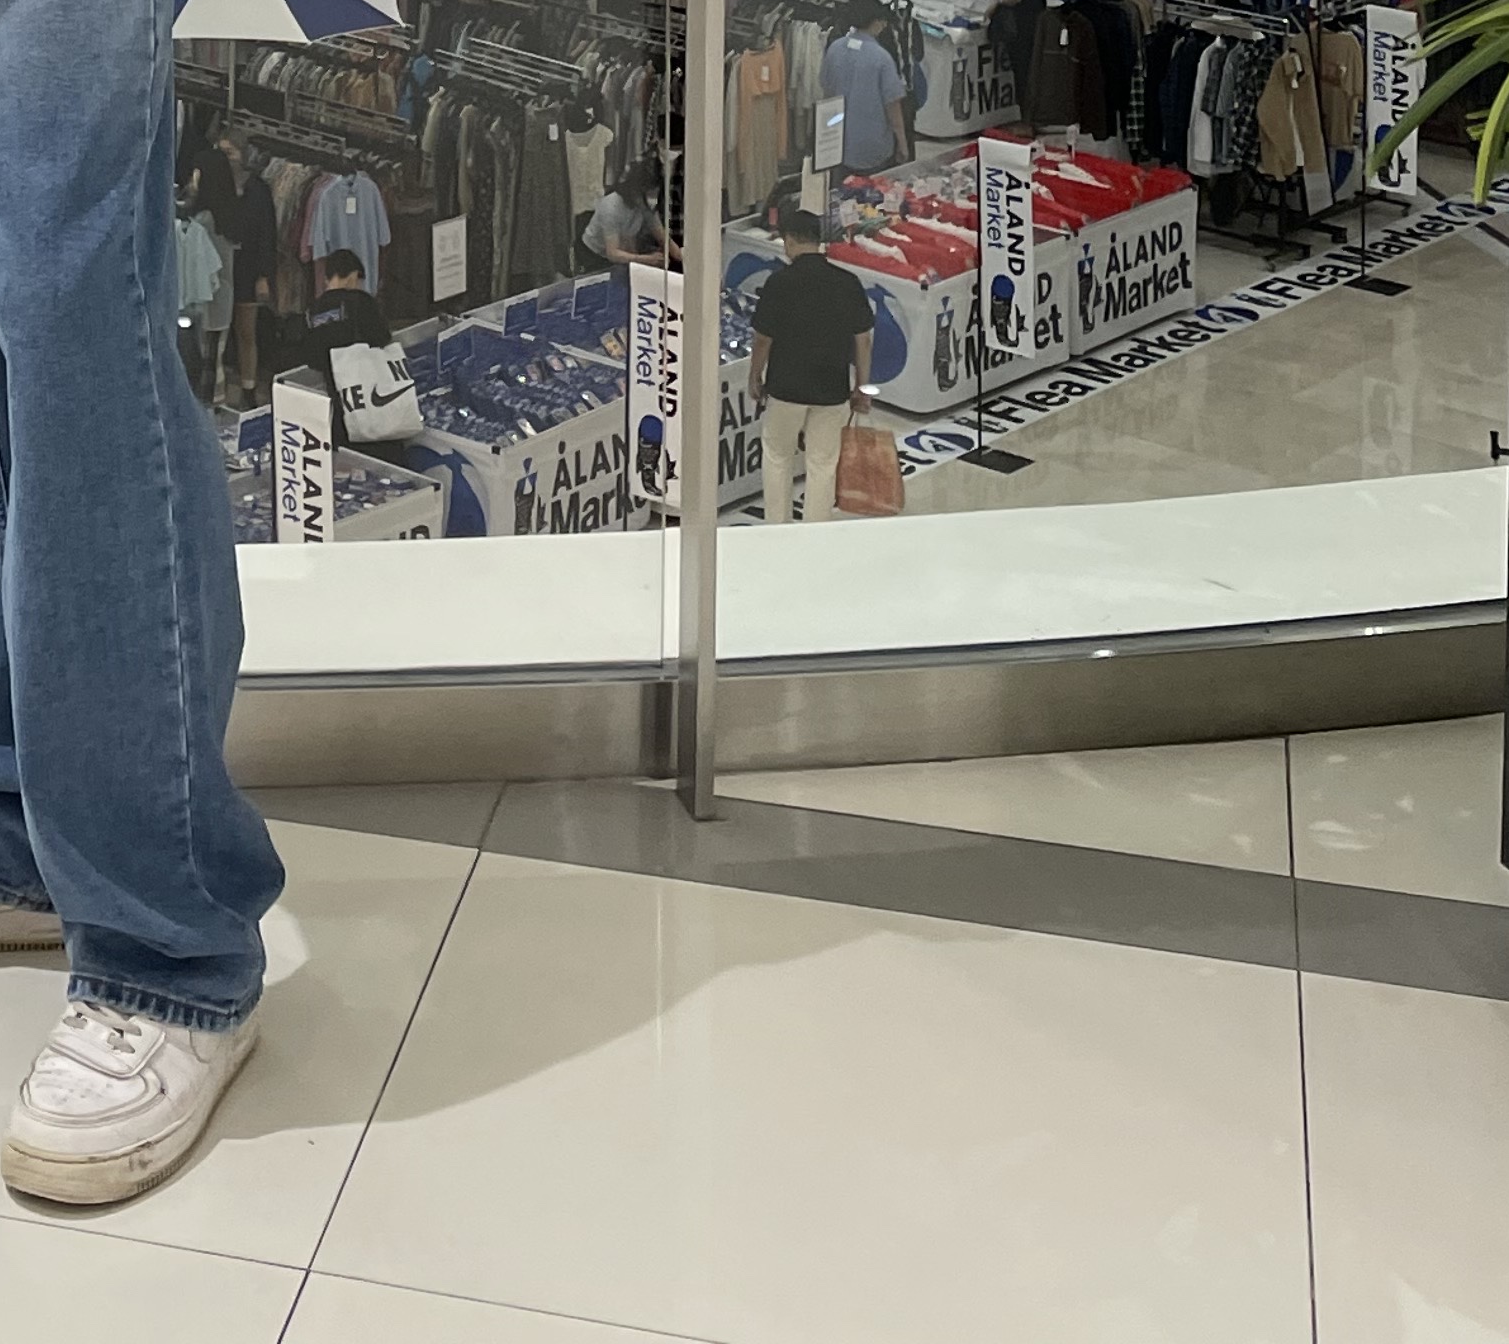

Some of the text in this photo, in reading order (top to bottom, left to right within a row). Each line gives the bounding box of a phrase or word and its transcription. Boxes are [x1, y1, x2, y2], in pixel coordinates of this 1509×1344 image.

[1372, 30, 1392, 103] Market
[983, 165, 1005, 251] Market
[1003, 169, 1032, 278] ÅLAND
[1103, 219, 1185, 280] ÅLAND
[1101, 250, 1194, 325] Market
[1251, 207, 1470, 304] Flea Market
[634, 294, 659, 389] Market
[976, 314, 1229, 426] Flea Market
[279, 420, 303, 524] Market
[552, 440, 628, 499] ÅLAN
